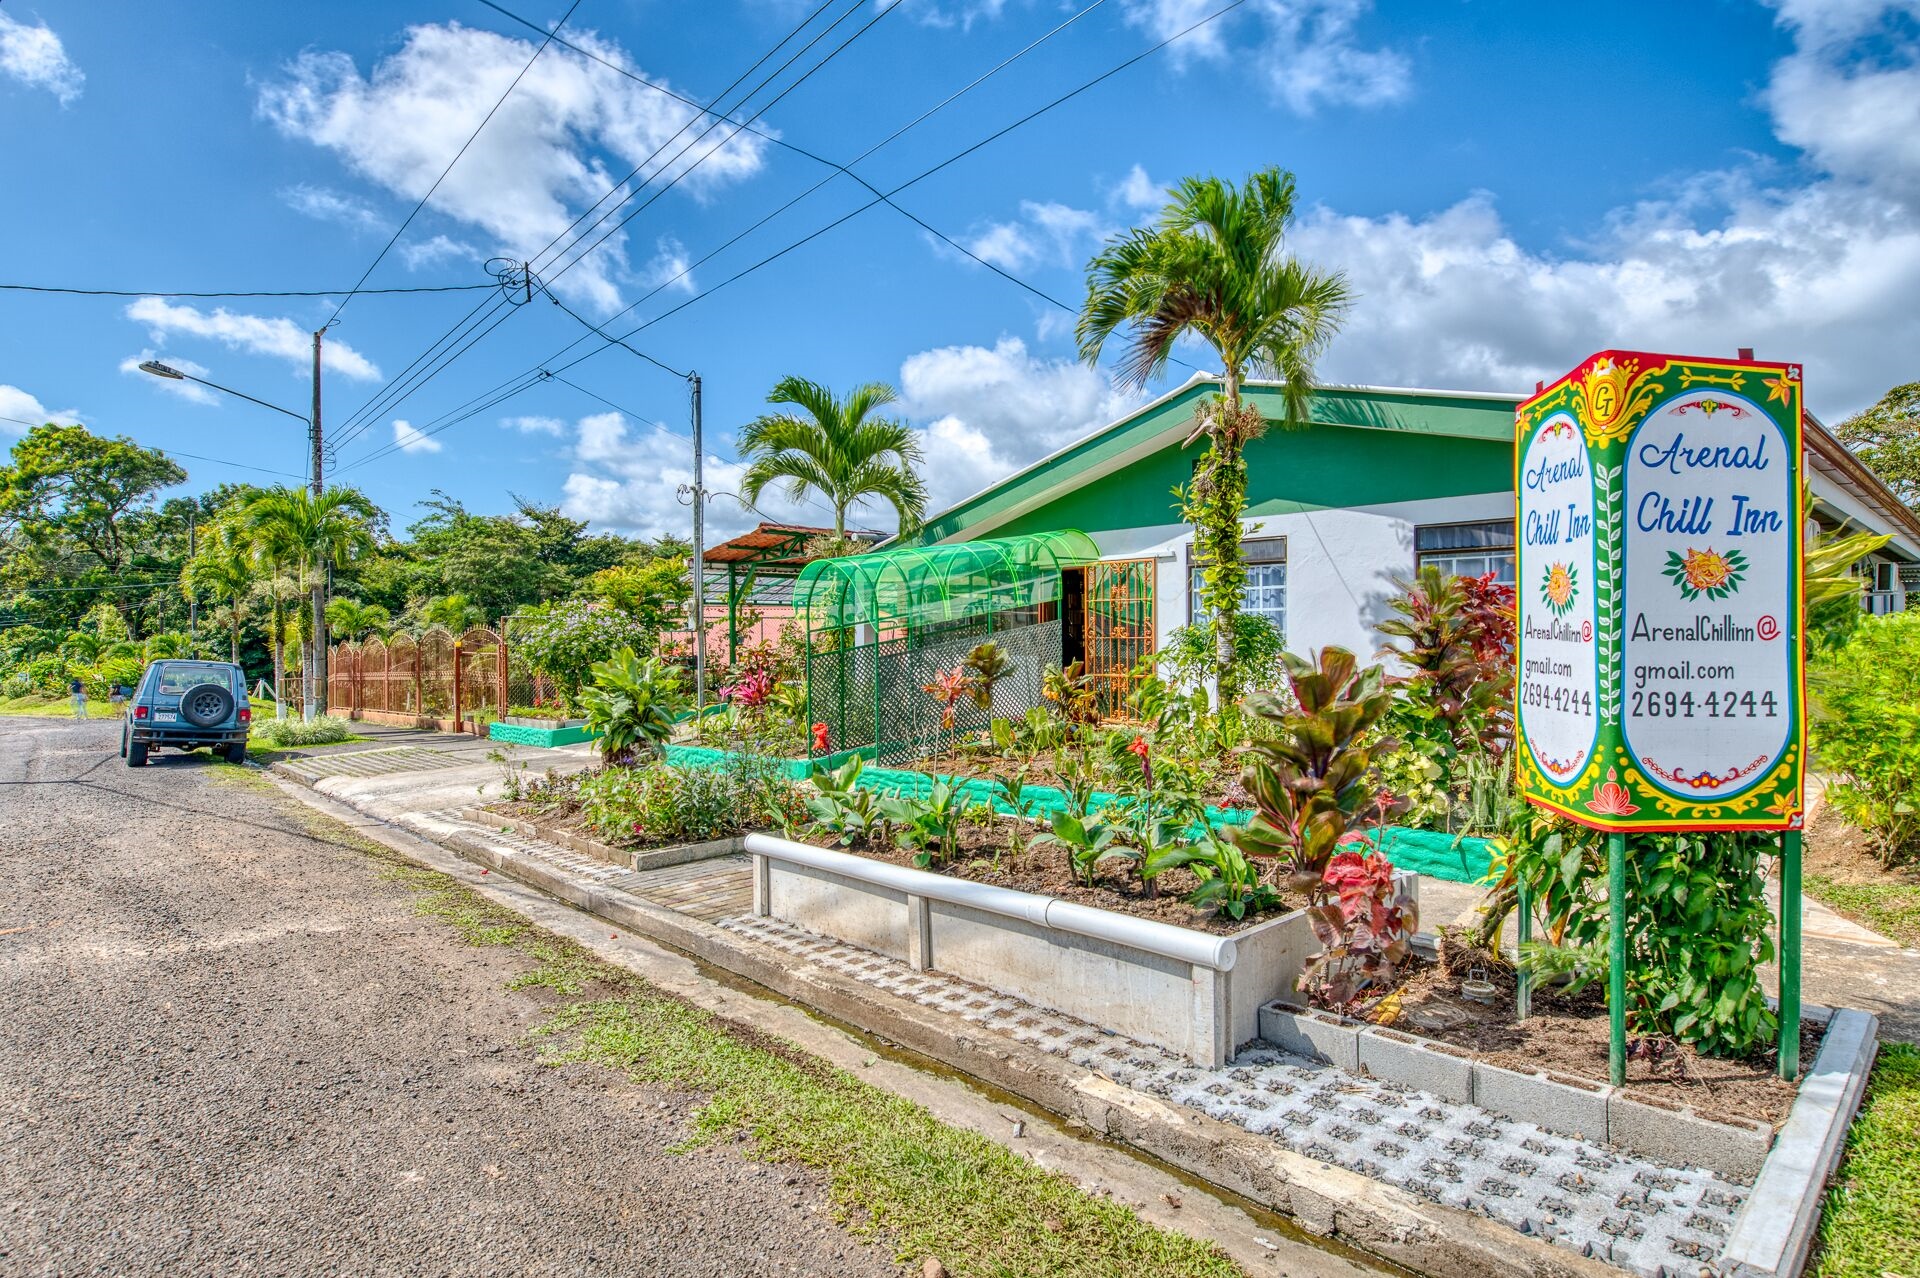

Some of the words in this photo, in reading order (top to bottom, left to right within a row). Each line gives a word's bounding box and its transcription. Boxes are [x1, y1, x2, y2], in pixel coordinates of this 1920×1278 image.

[1526, 443, 1584, 492] Arenal
[1639, 433, 1768, 474] Arenal
[1526, 509, 1560, 546] Chill
[1565, 503, 1591, 543] Inn
[1637, 491, 1713, 535] Chill
[1726, 495, 1782, 536] Inn
[1525, 656, 1572, 679] gmail.com
[1634, 660, 1735, 689] gmail.com
